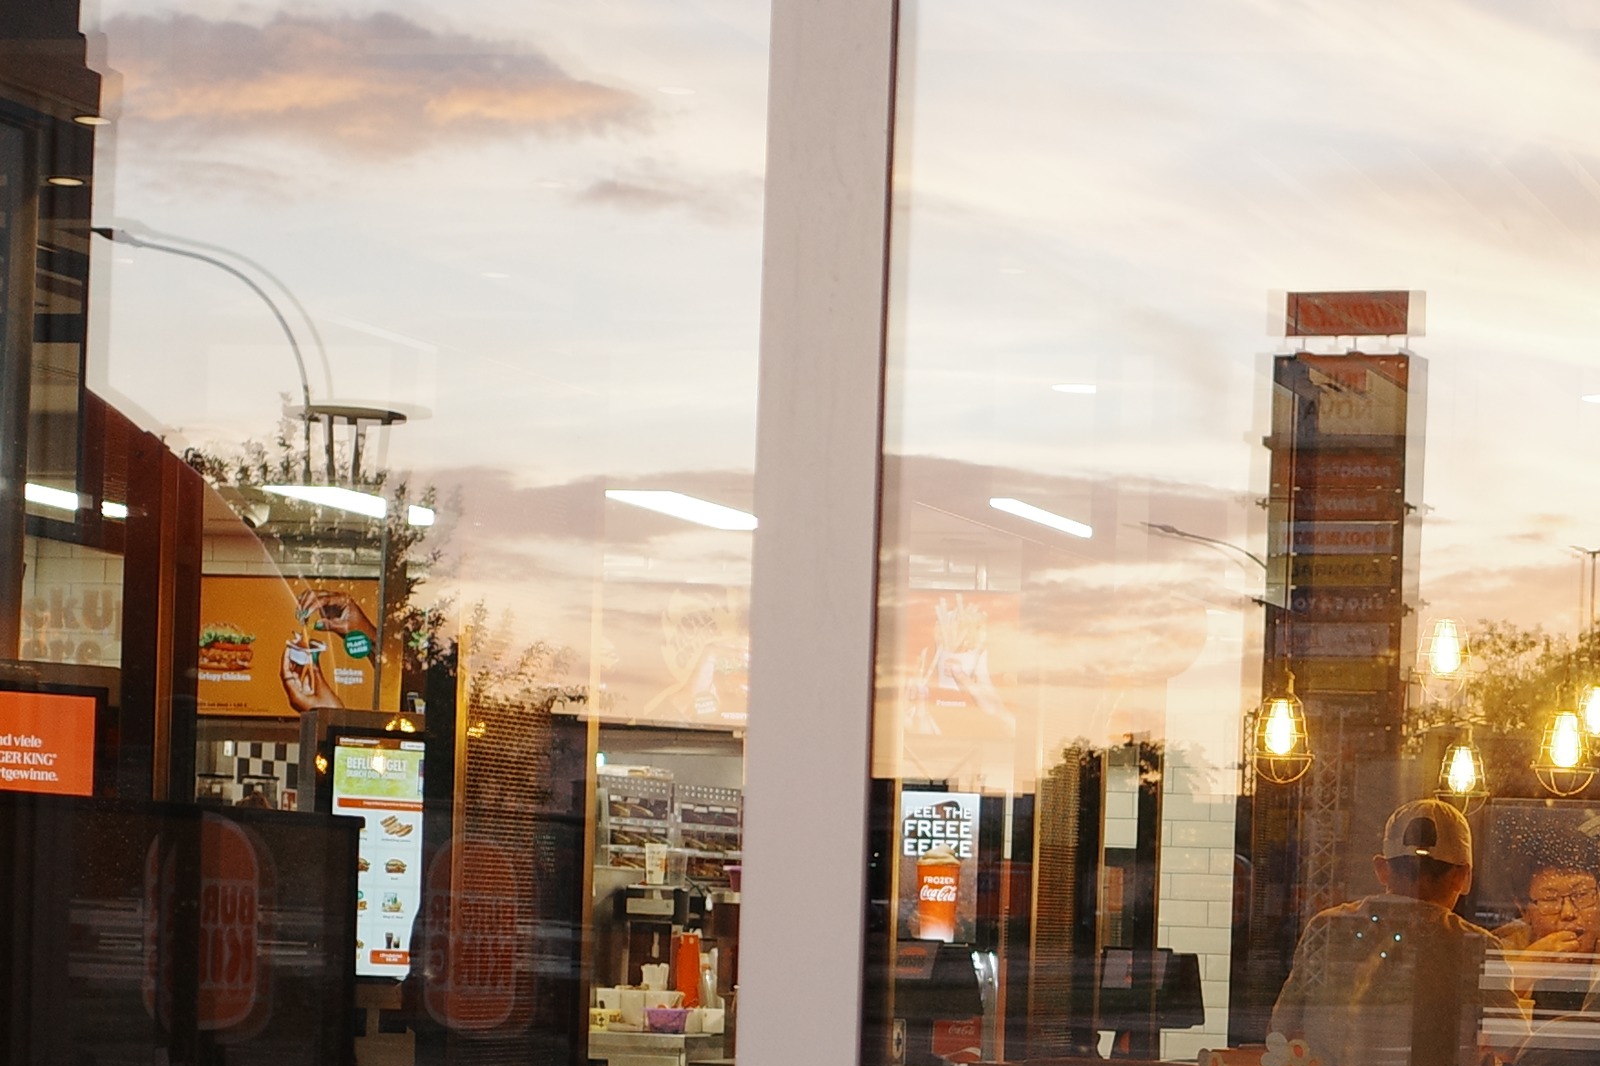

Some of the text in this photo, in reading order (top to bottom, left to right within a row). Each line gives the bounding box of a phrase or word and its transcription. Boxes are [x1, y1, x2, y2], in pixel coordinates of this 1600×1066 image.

[222, 672, 251, 681] Chicken
[14, 734, 42, 748] viele
[0, 767, 59, 782] tgewinne.
[943, 806, 972, 819] THE
[904, 819, 972, 838] FREEE
[923, 876, 955, 885] FROZEN
